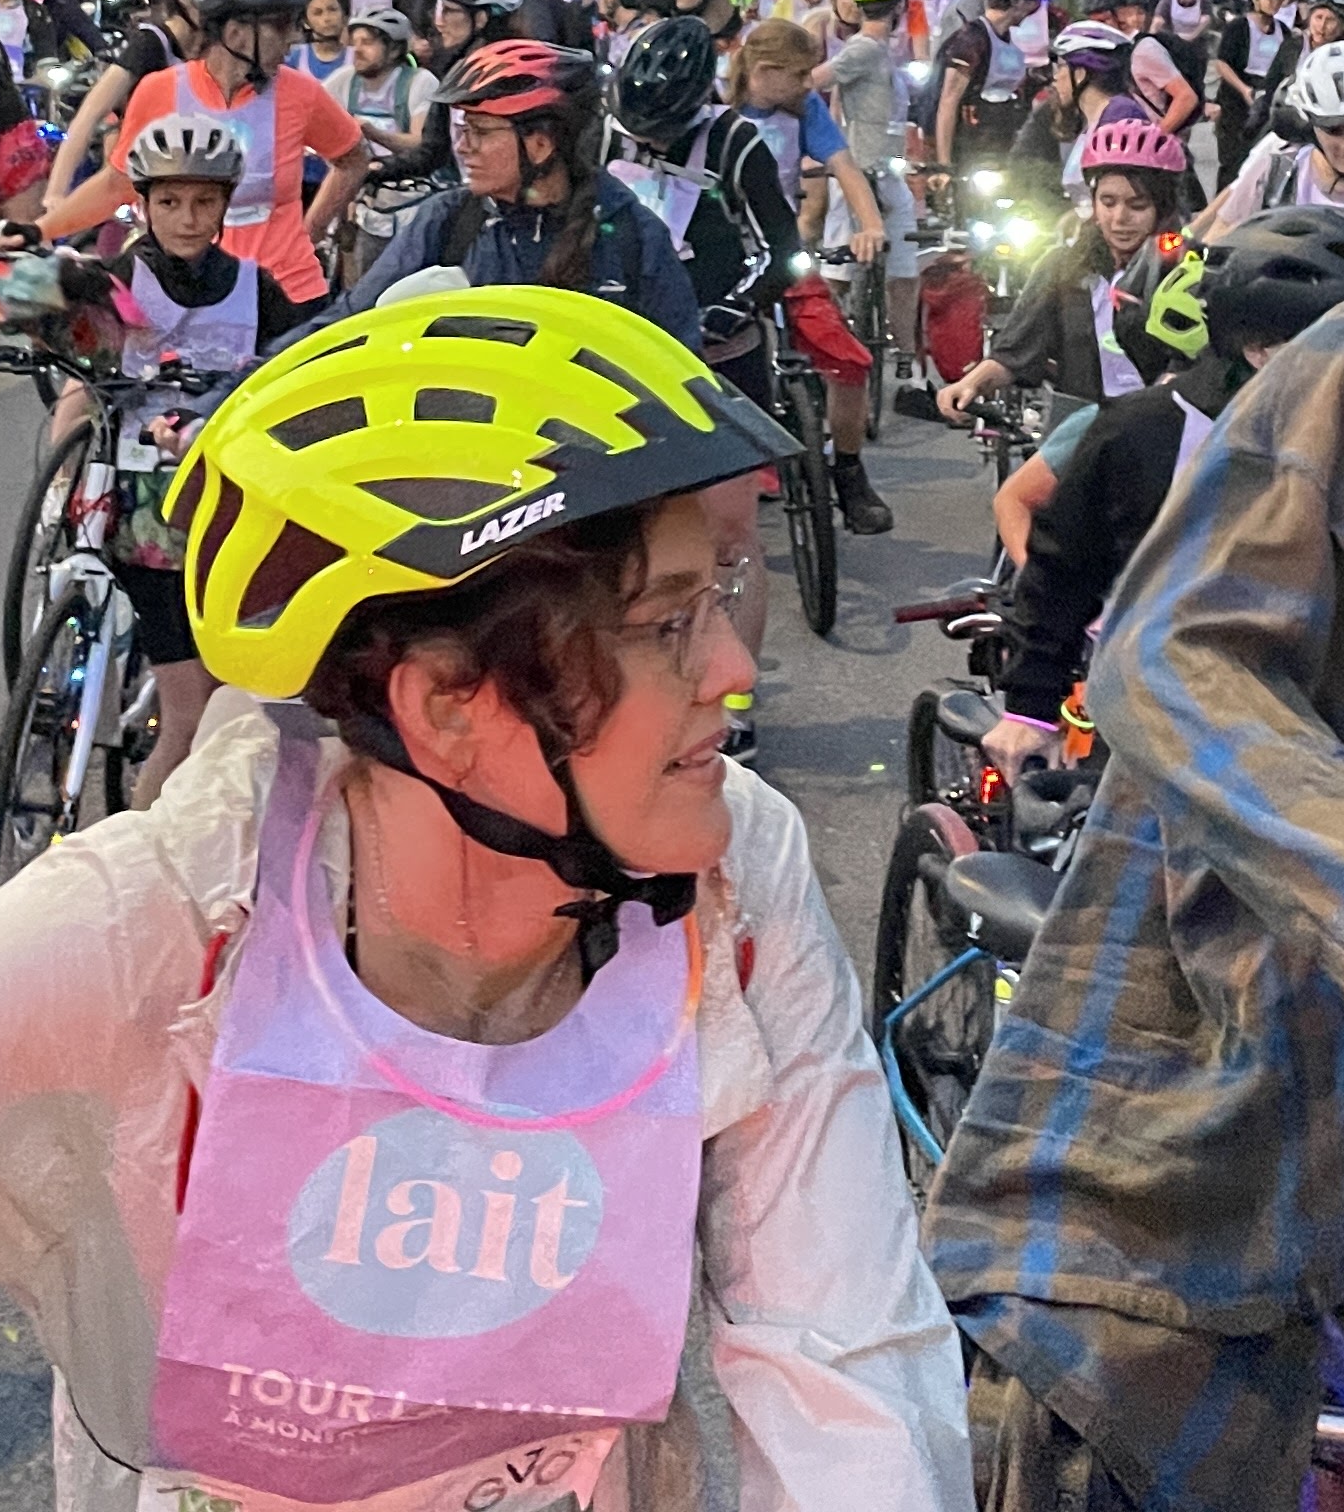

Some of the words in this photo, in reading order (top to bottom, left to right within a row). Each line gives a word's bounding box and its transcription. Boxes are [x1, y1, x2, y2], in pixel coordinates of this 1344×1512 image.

[460, 491, 567, 556] LAZER
[322, 1135, 590, 1290] lait
[222, 1362, 377, 1424] TOUR
